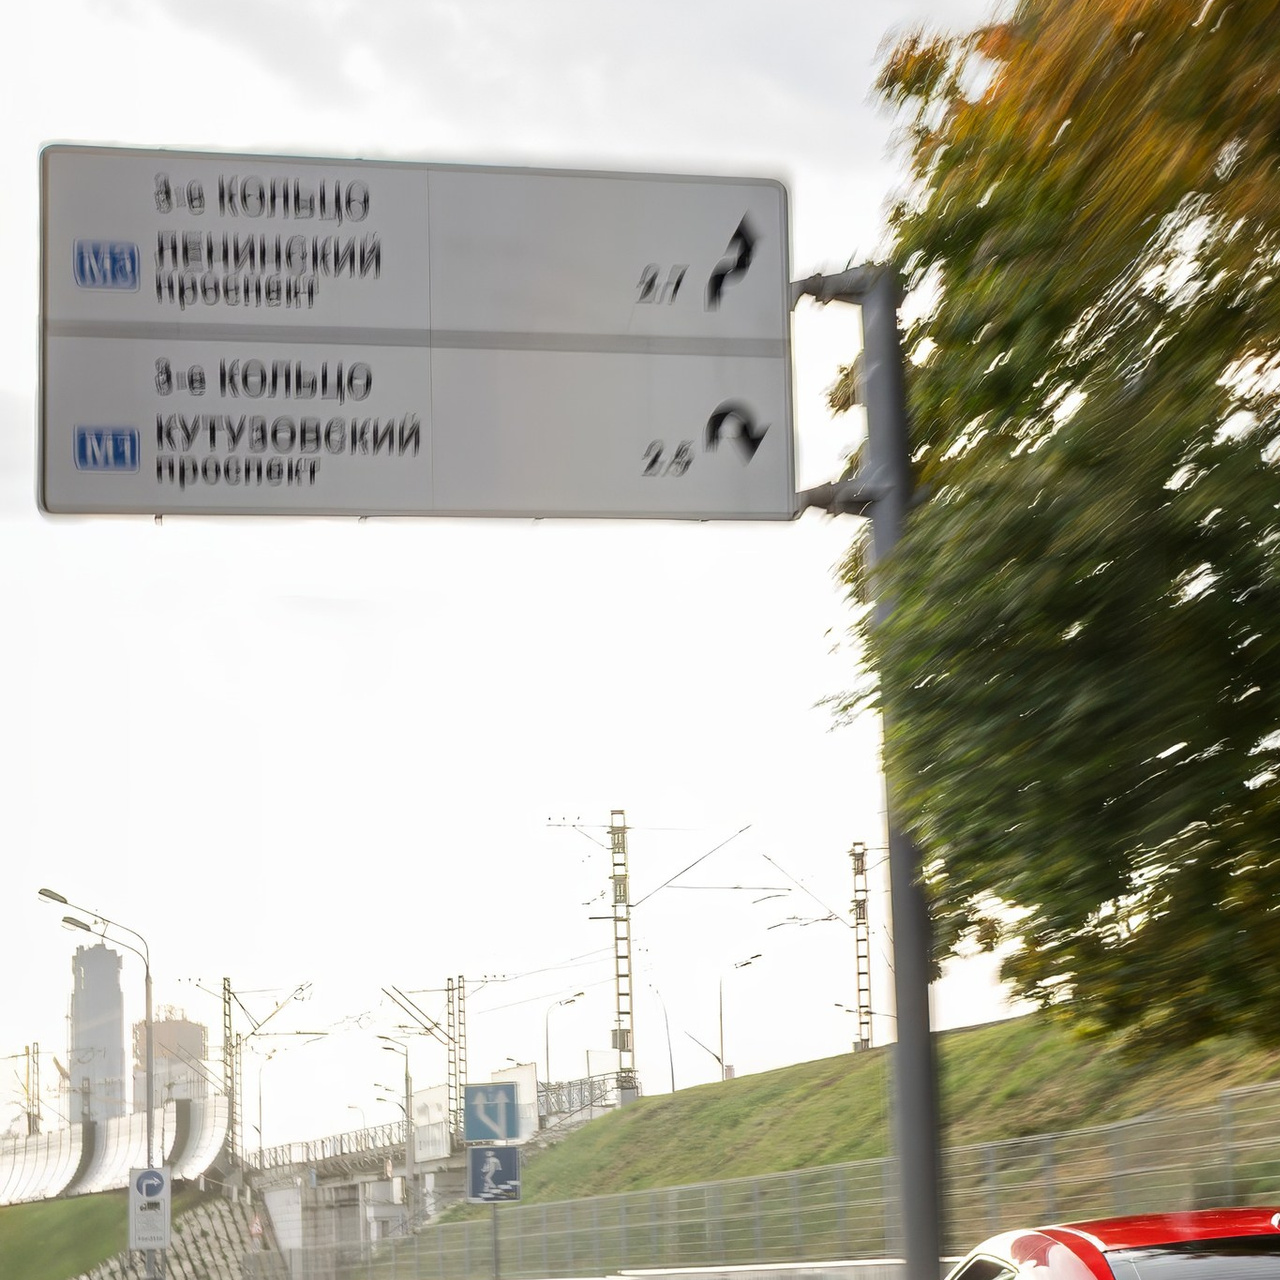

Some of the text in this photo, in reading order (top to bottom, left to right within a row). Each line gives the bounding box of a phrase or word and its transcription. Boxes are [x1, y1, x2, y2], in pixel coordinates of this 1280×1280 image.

[218, 174, 370, 227] КОЛЬЦО
[219, 357, 373, 406] КОЛЬЦО
[156, 412, 421, 458] КУТУЗОВСКИЙ
